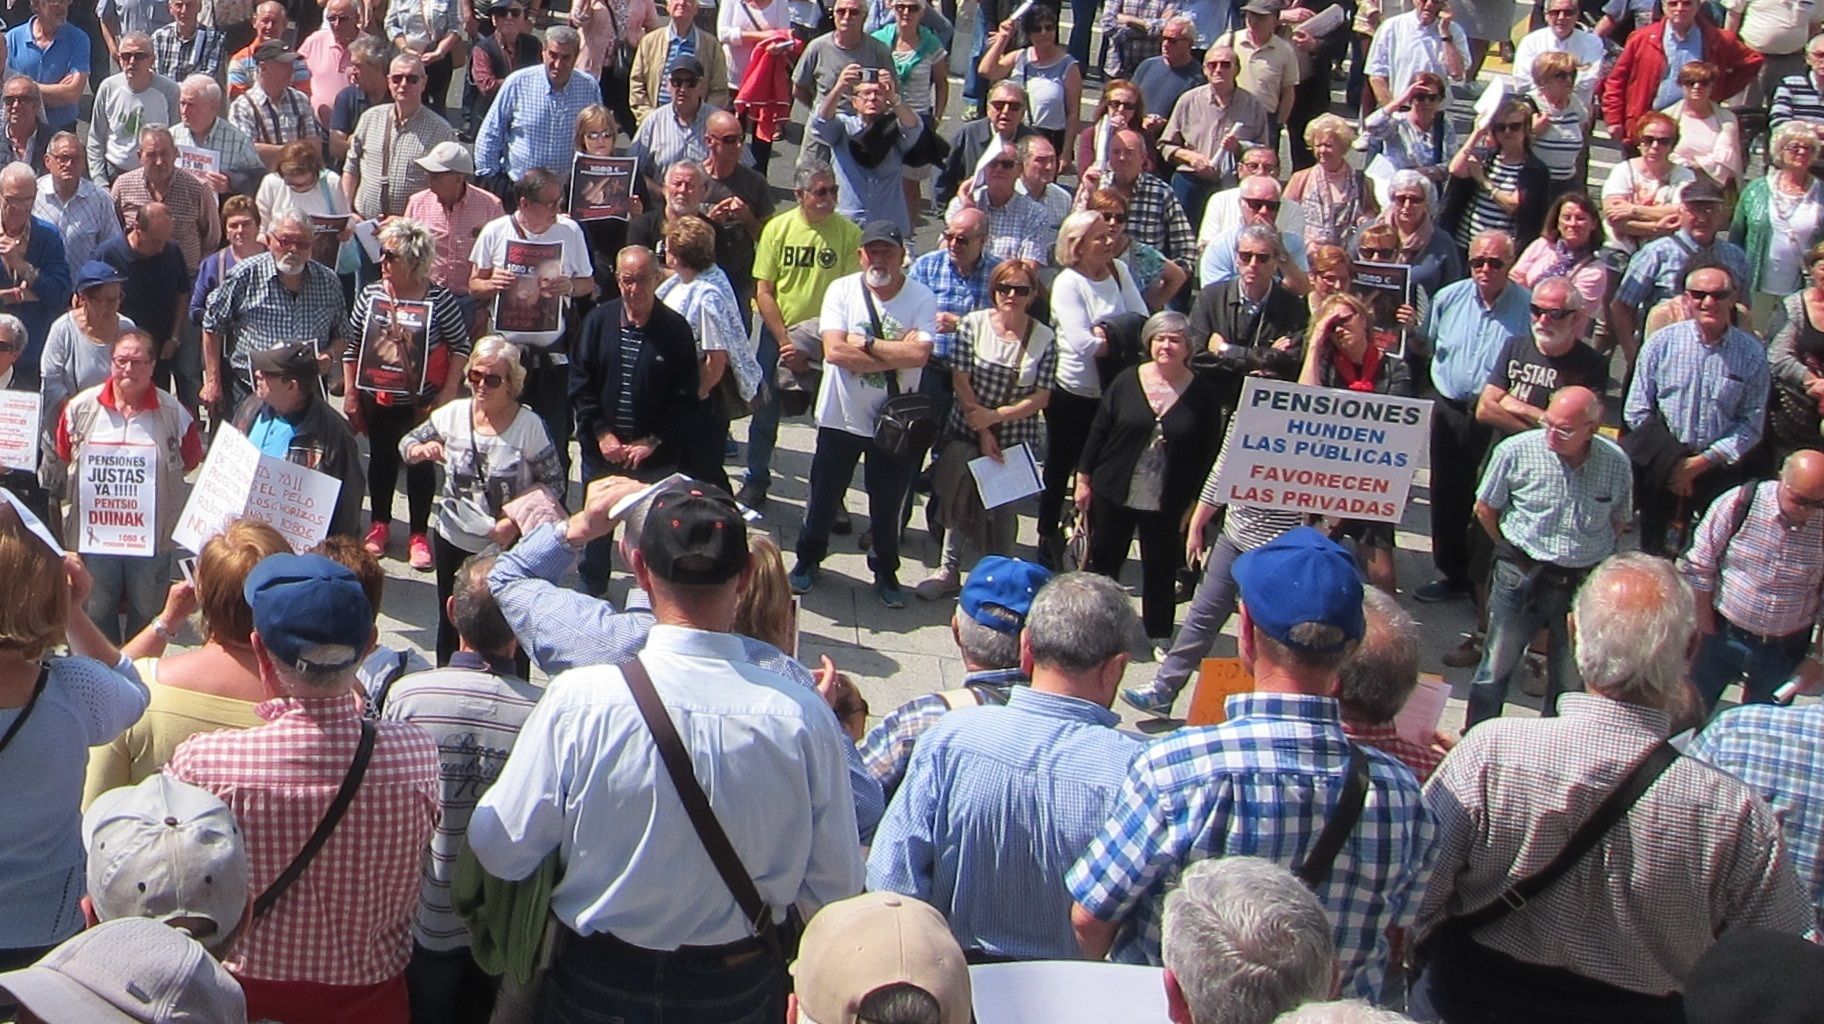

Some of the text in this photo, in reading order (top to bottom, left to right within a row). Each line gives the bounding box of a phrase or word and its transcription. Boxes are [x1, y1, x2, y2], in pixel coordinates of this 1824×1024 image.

[1508, 360, 1558, 388] G-STAR
[1252, 389, 1421, 425] PENSIONES
[1287, 419, 1386, 444] HUNDEN
[1242, 434, 1287, 454] LAS
[88, 455, 146, 468] PENSIONES
[88, 468, 145, 484] JUSTAS
[1250, 464, 1390, 494] FAVORECEN
[94, 484, 110, 496] YA
[260, 484, 276, 496] EL
[94, 498, 138, 510] PENTSIO
[1230, 485, 1396, 517] LAS PRIVADAS
[88, 510, 144, 527] DUINAK
[186, 514, 206, 535] NO
